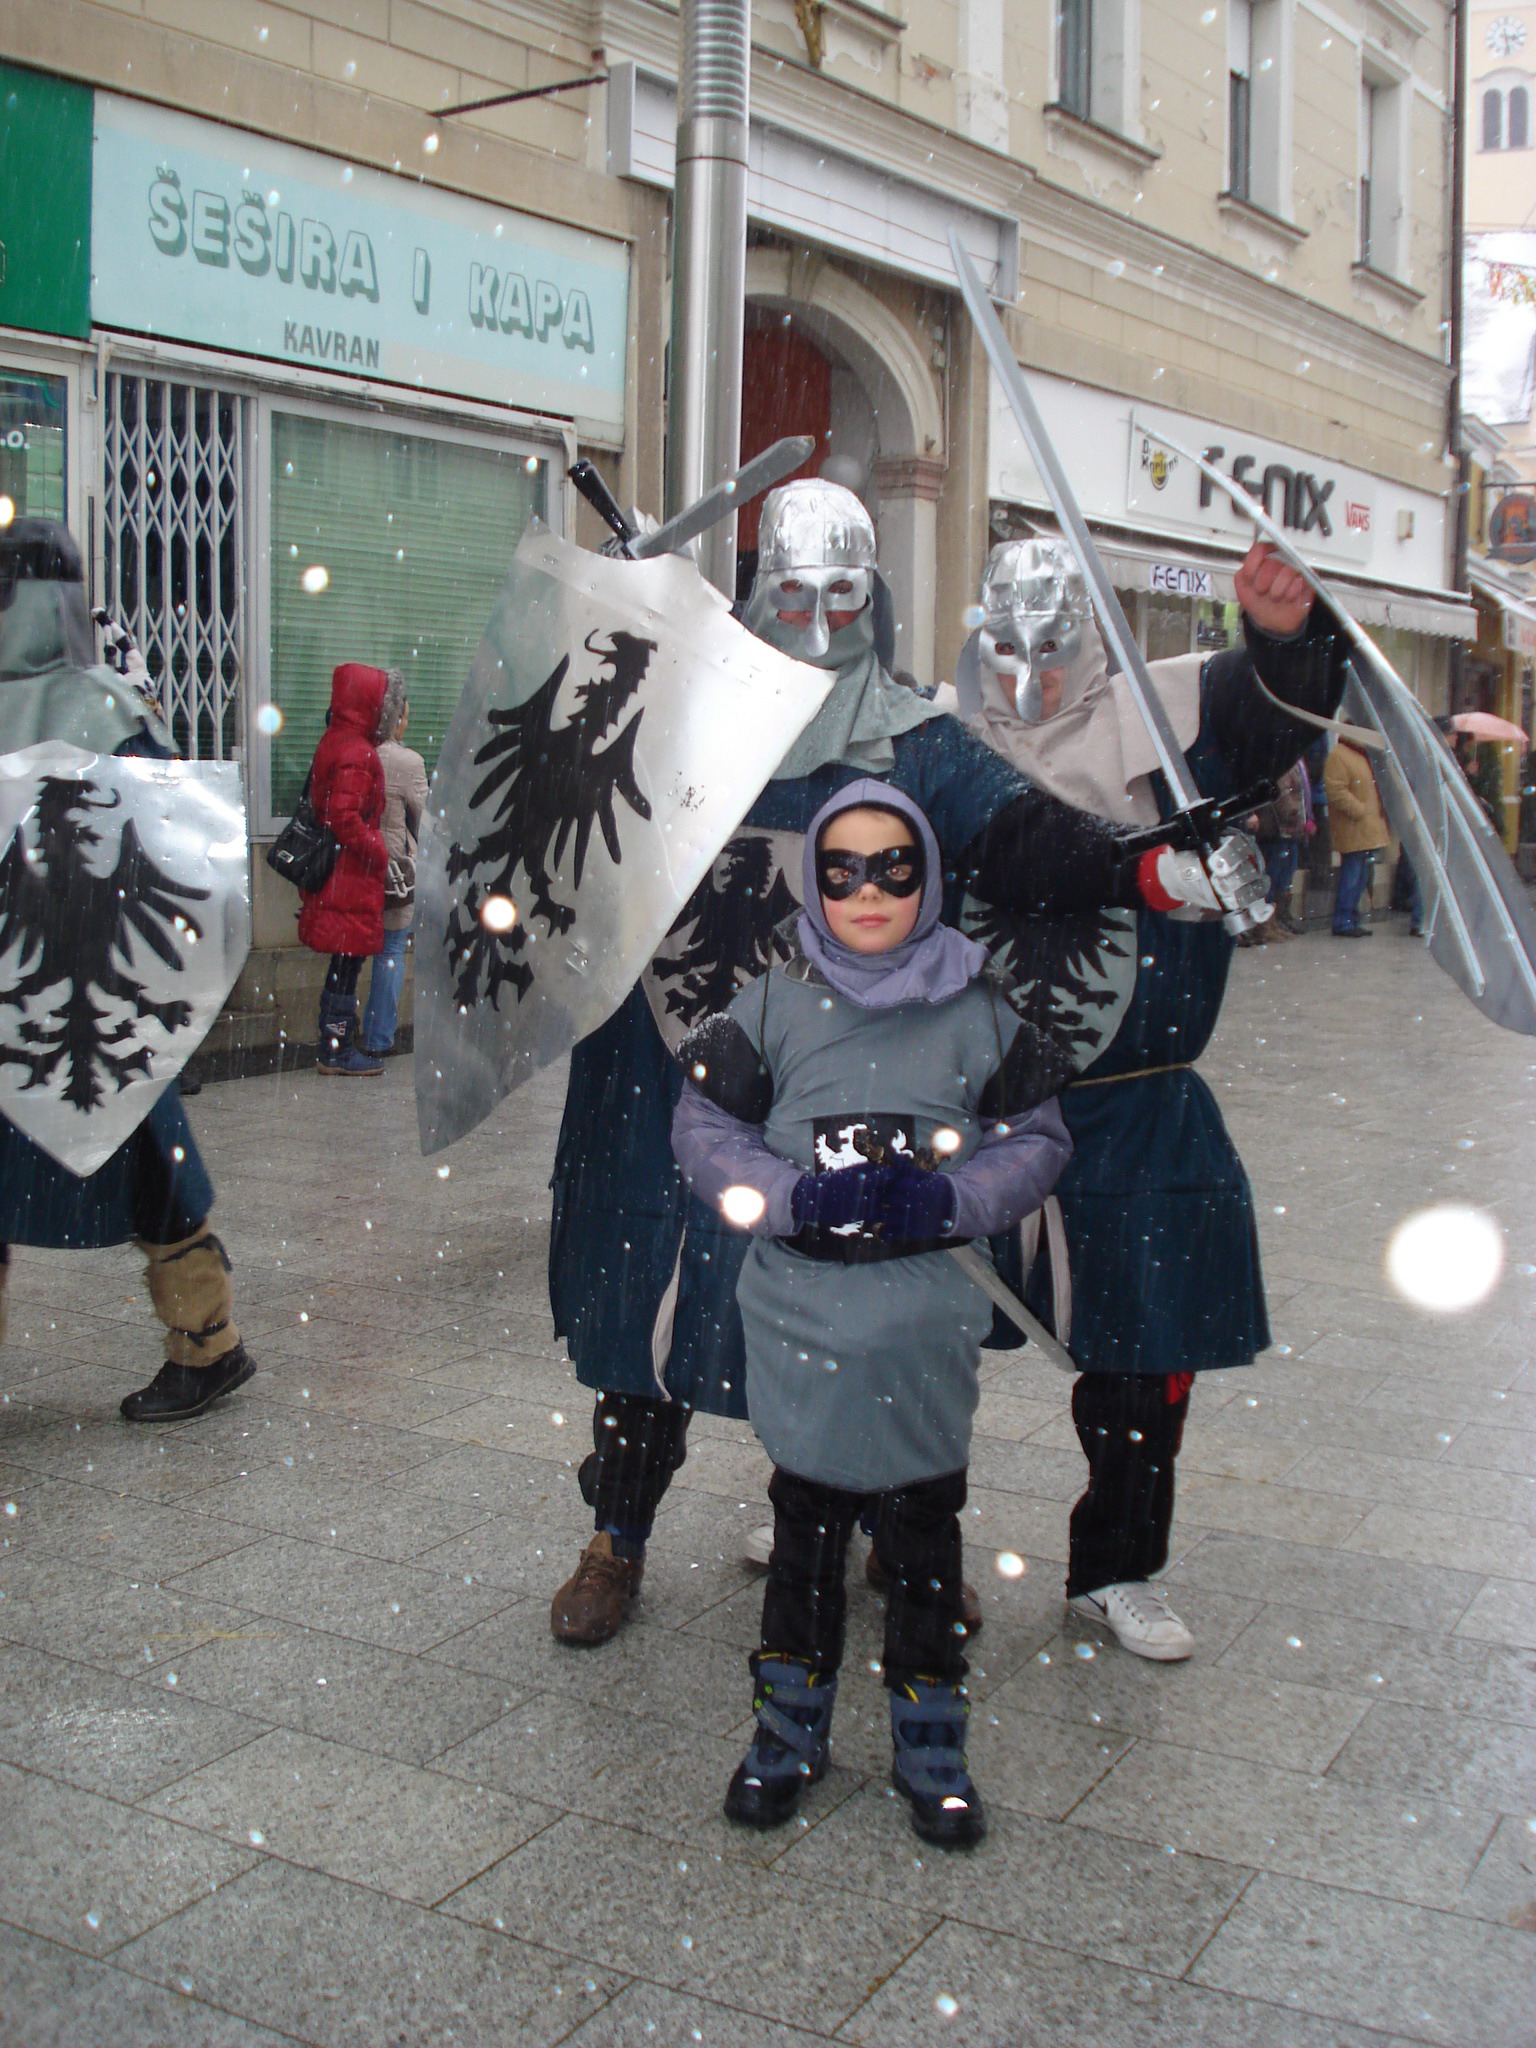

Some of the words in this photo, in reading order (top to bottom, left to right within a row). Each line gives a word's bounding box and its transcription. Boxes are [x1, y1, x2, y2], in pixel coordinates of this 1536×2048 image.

[149, 166, 380, 303] ŠEŠIRA
[413, 247, 431, 315] I
[469, 261, 595, 354] KAPA
[284, 320, 380, 368] KAVRAN
[1153, 565, 1207, 592] FENIX
